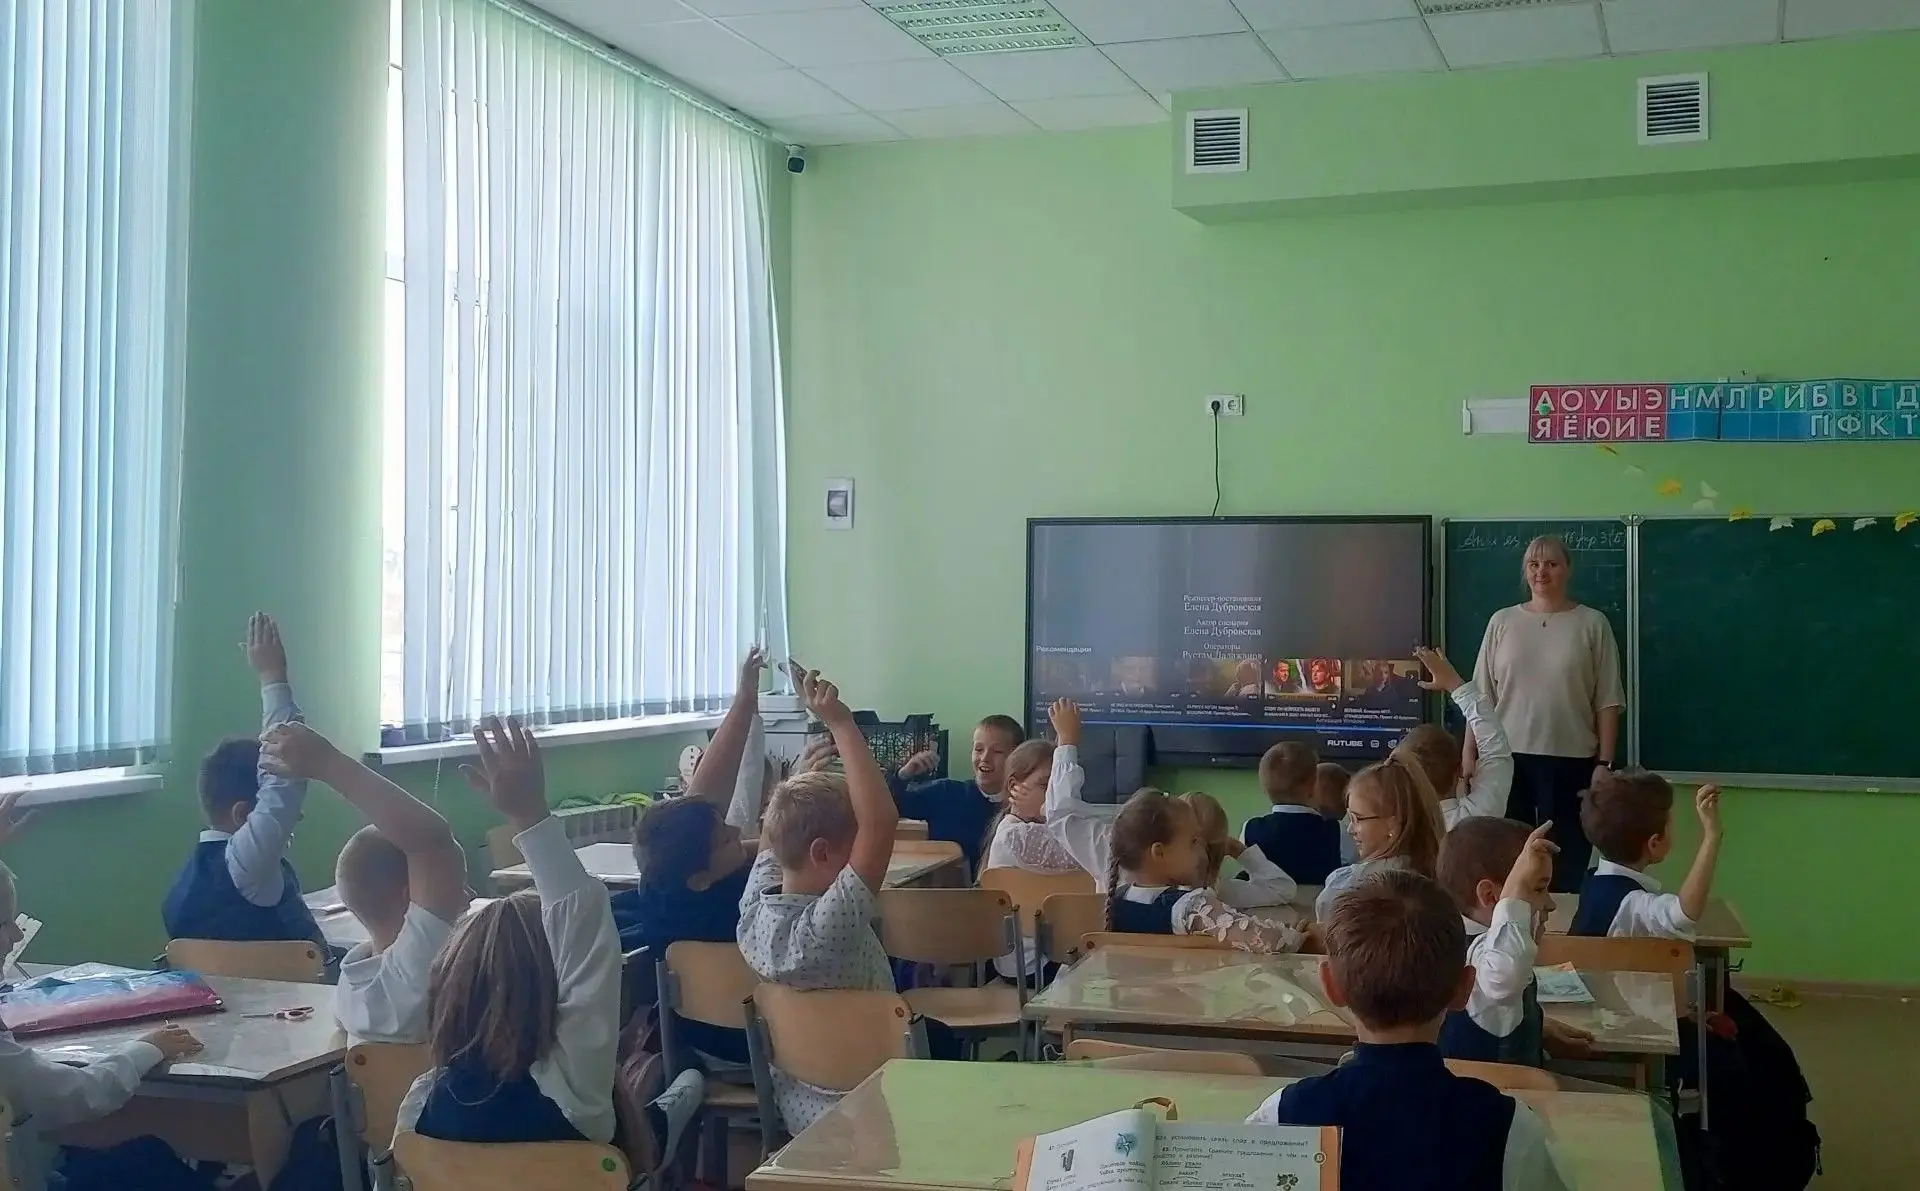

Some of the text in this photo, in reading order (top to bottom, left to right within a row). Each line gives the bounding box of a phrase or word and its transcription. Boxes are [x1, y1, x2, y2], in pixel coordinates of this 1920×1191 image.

[1534, 383, 1920, 413] А О У Ы Э Н М Л Р Й Б В Г Д
[1535, 413, 1918, 439] Я Ё Ю И Е П Ф К Т
[1184, 602, 1262, 613] Елена Дубровская
[1196, 618, 1217, 627] Автор
[1184, 626, 1262, 637] Елена Дубровская
[1036, 645, 1092, 653] Рекомендации
[1203, 642, 1241, 651] Операторы
[1182, 650, 1212, 659] Рустам
[1327, 739, 1364, 747] RUTUBE
